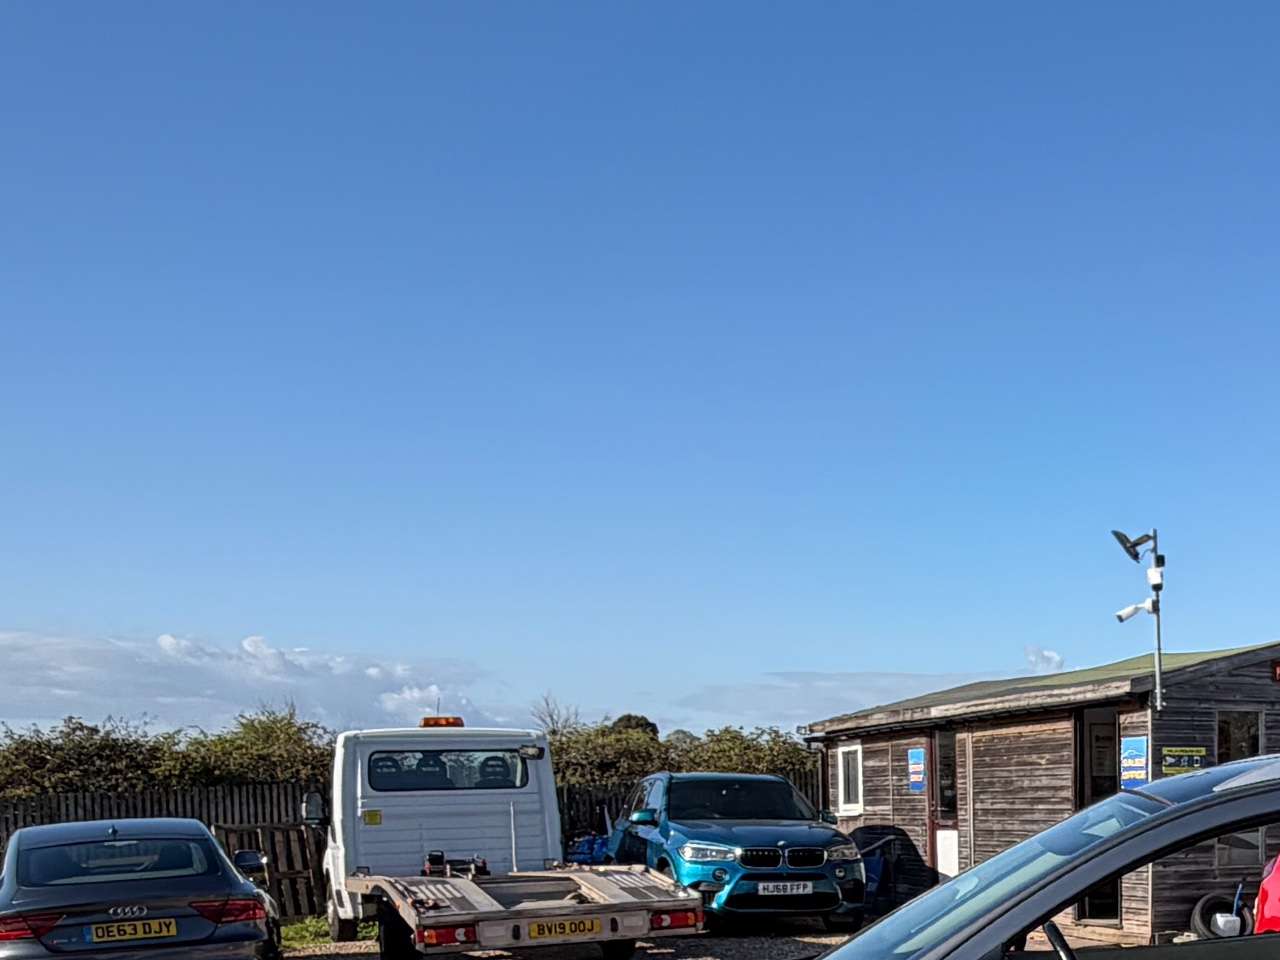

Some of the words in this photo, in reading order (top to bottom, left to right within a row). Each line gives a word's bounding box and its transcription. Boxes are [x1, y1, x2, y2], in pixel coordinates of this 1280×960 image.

[95, 923, 138, 939] OE63
[142, 920, 172, 935] DJY
[537, 922, 566, 936] BV19
